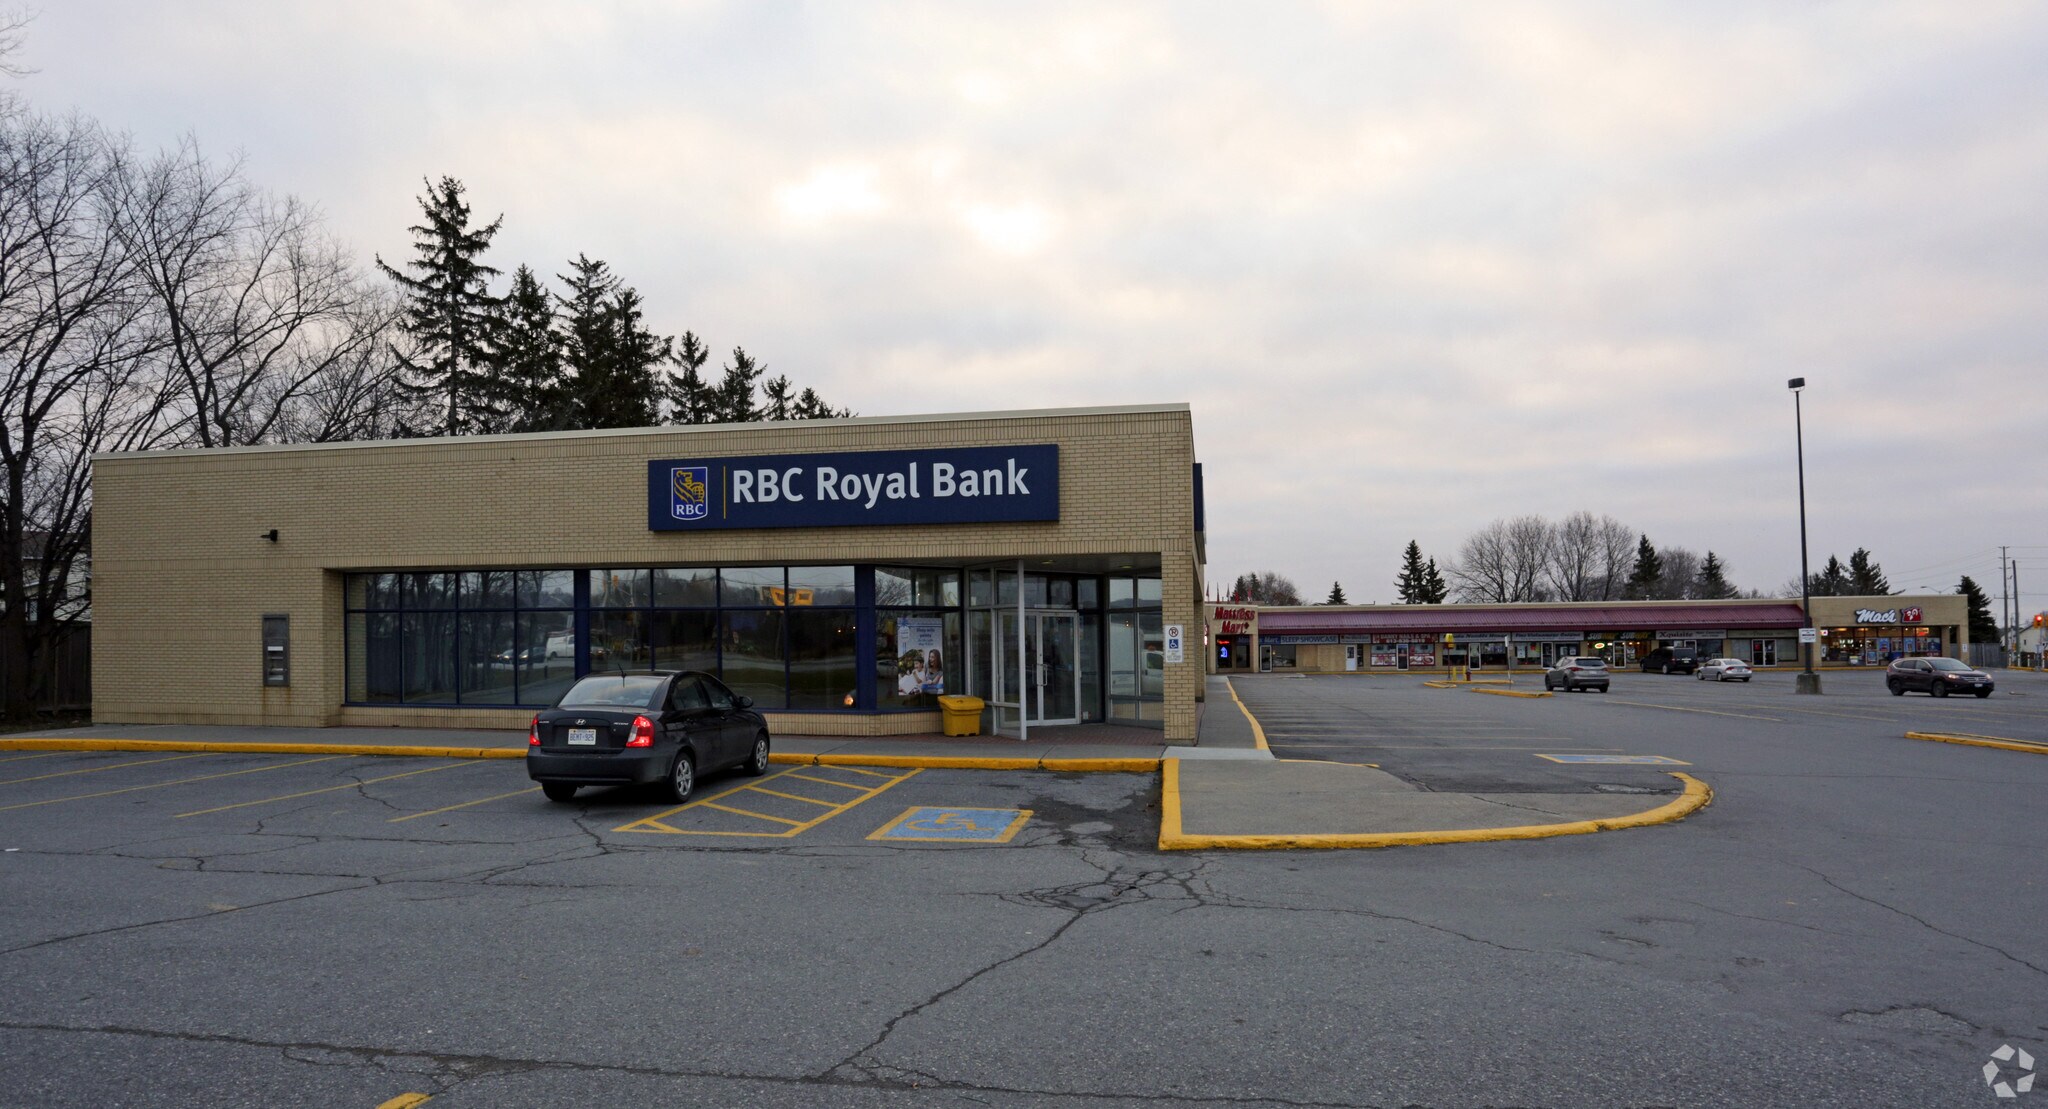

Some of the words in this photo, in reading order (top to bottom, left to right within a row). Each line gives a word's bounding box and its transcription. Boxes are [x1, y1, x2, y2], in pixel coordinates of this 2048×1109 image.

[733, 467, 804, 503] RBC
[817, 462, 920, 510] Royal
[933, 458, 1030, 497] Bank
[676, 504, 704, 515] RBC
[1213, 607, 1255, 620] Mattress
[1856, 608, 1897, 623] Mac's
[1221, 621, 1248, 634] Mart
[1281, 635, 1299, 643] SLEEP
[1300, 635, 1337, 643] SHOWCASE
